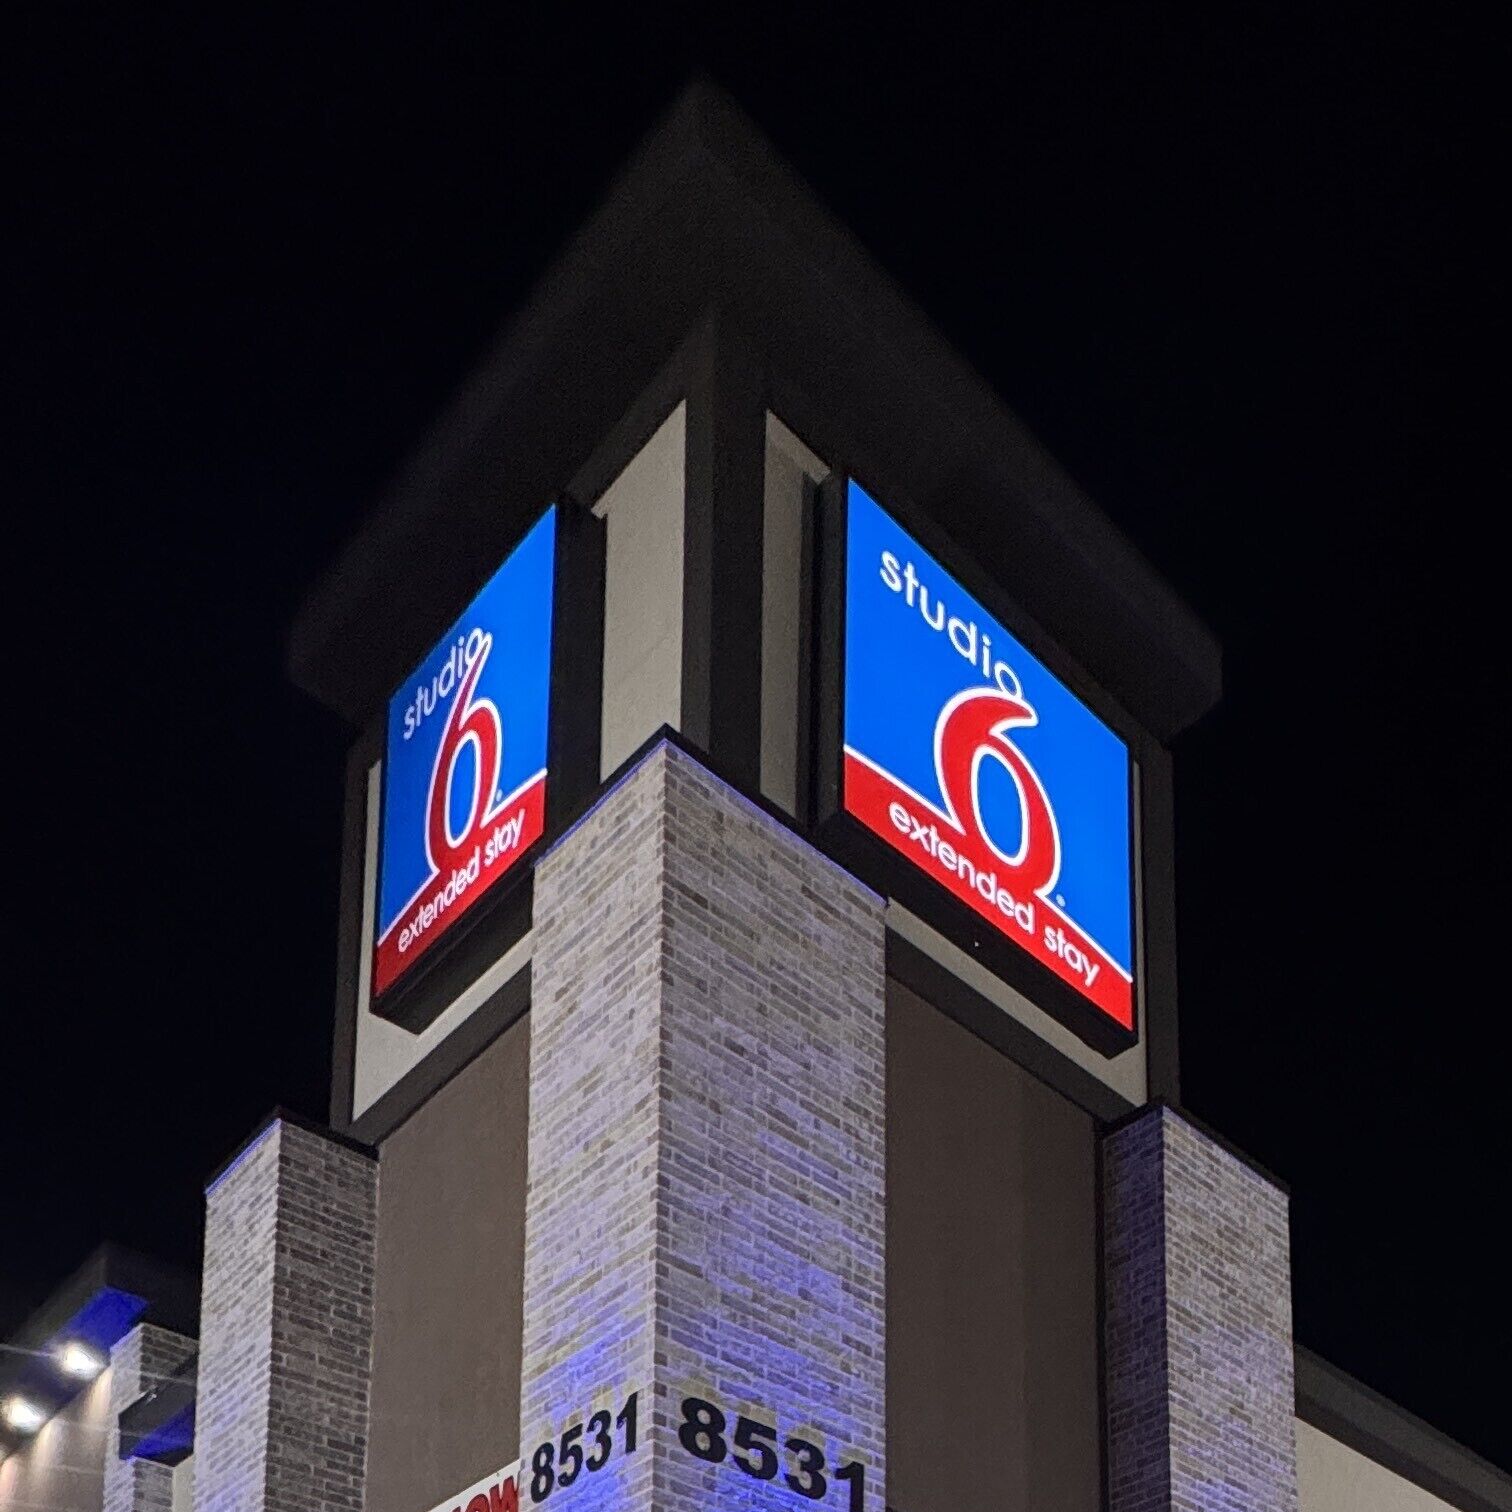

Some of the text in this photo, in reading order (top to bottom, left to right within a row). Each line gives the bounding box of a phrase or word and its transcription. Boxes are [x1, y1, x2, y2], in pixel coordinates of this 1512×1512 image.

[403, 627, 484, 740] studio
[880, 551, 1024, 700] studio
[425, 631, 502, 873] 6
[934, 686, 1061, 899] 6
[397, 808, 526, 953] extended stay
[889, 801, 1100, 987] extended stay
[530, 1392, 640, 1504] 8531
